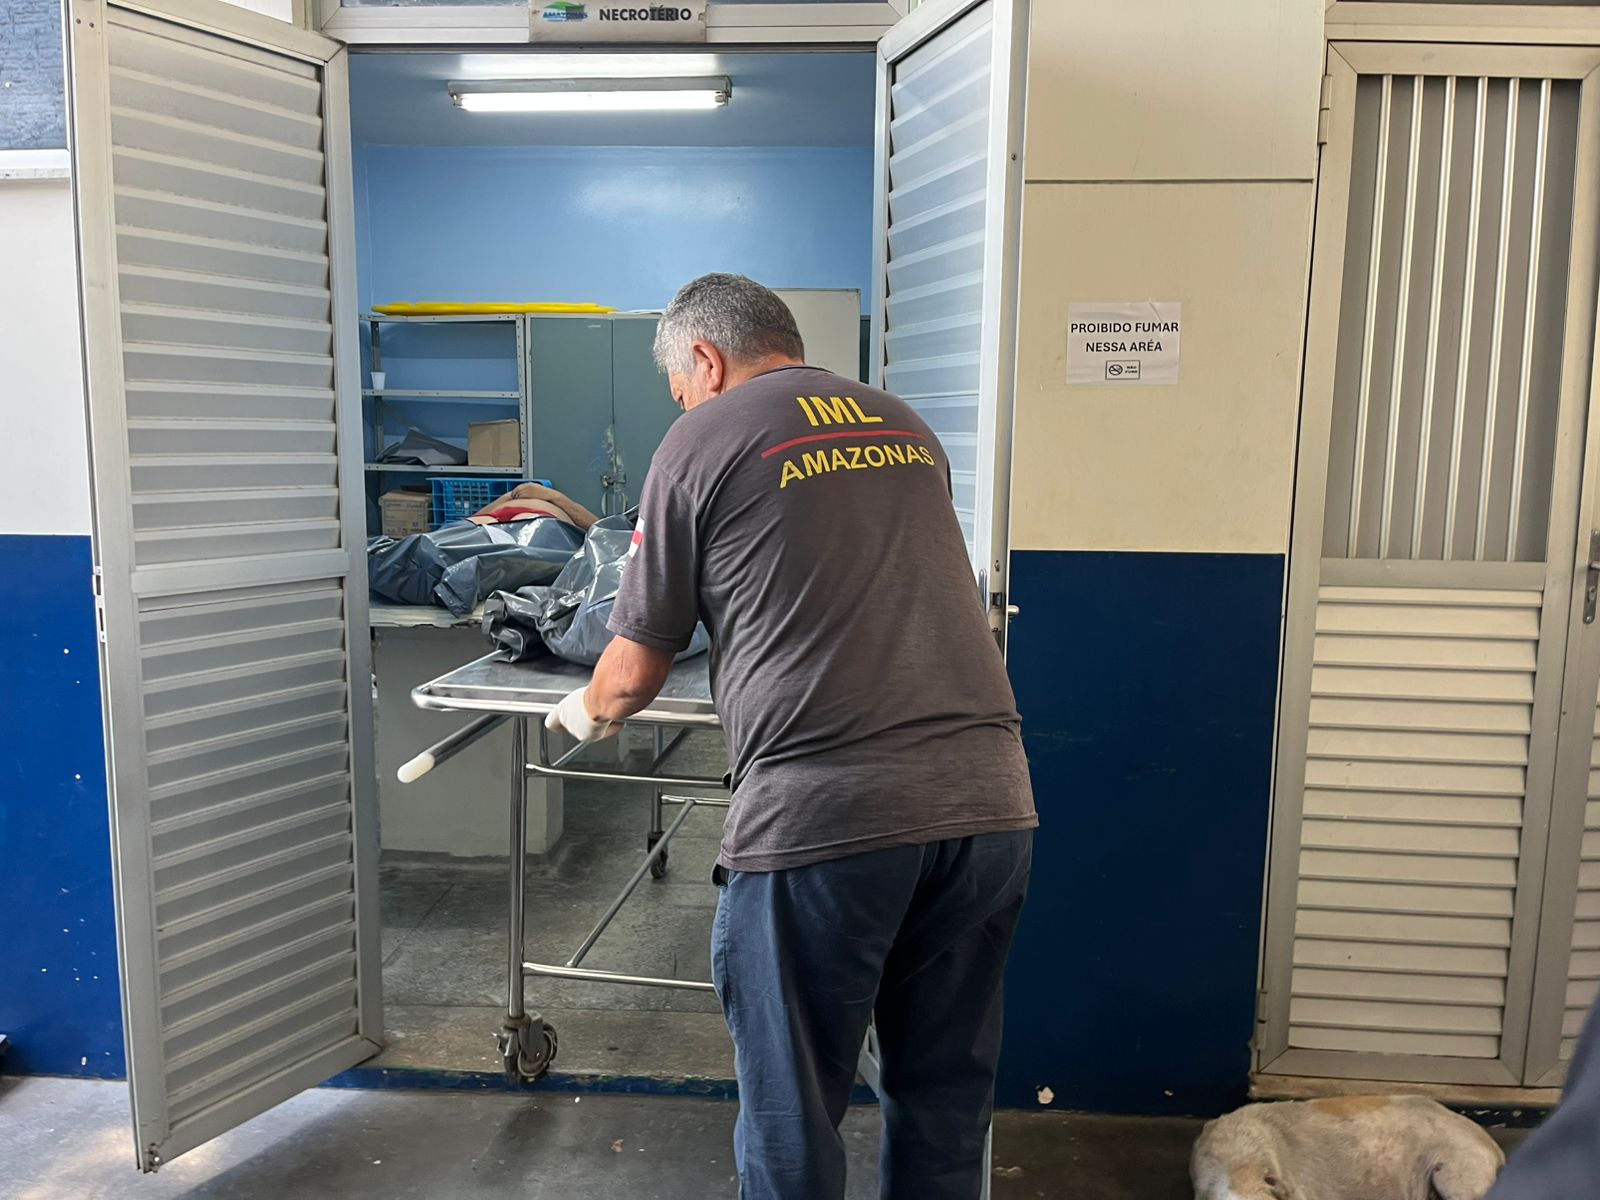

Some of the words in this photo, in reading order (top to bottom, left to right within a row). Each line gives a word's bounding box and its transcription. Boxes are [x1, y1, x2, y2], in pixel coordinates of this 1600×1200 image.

[599, 5, 692, 21] NECROTÉRIO
[1071, 323, 1132, 333] PROIBIDO
[1135, 322, 1179, 333] FUMAR
[1086, 342, 1127, 352] NESSA
[1130, 339, 1163, 352] ARÉA
[796, 396, 883, 427] IML
[779, 444, 935, 489] AMAZONAS
